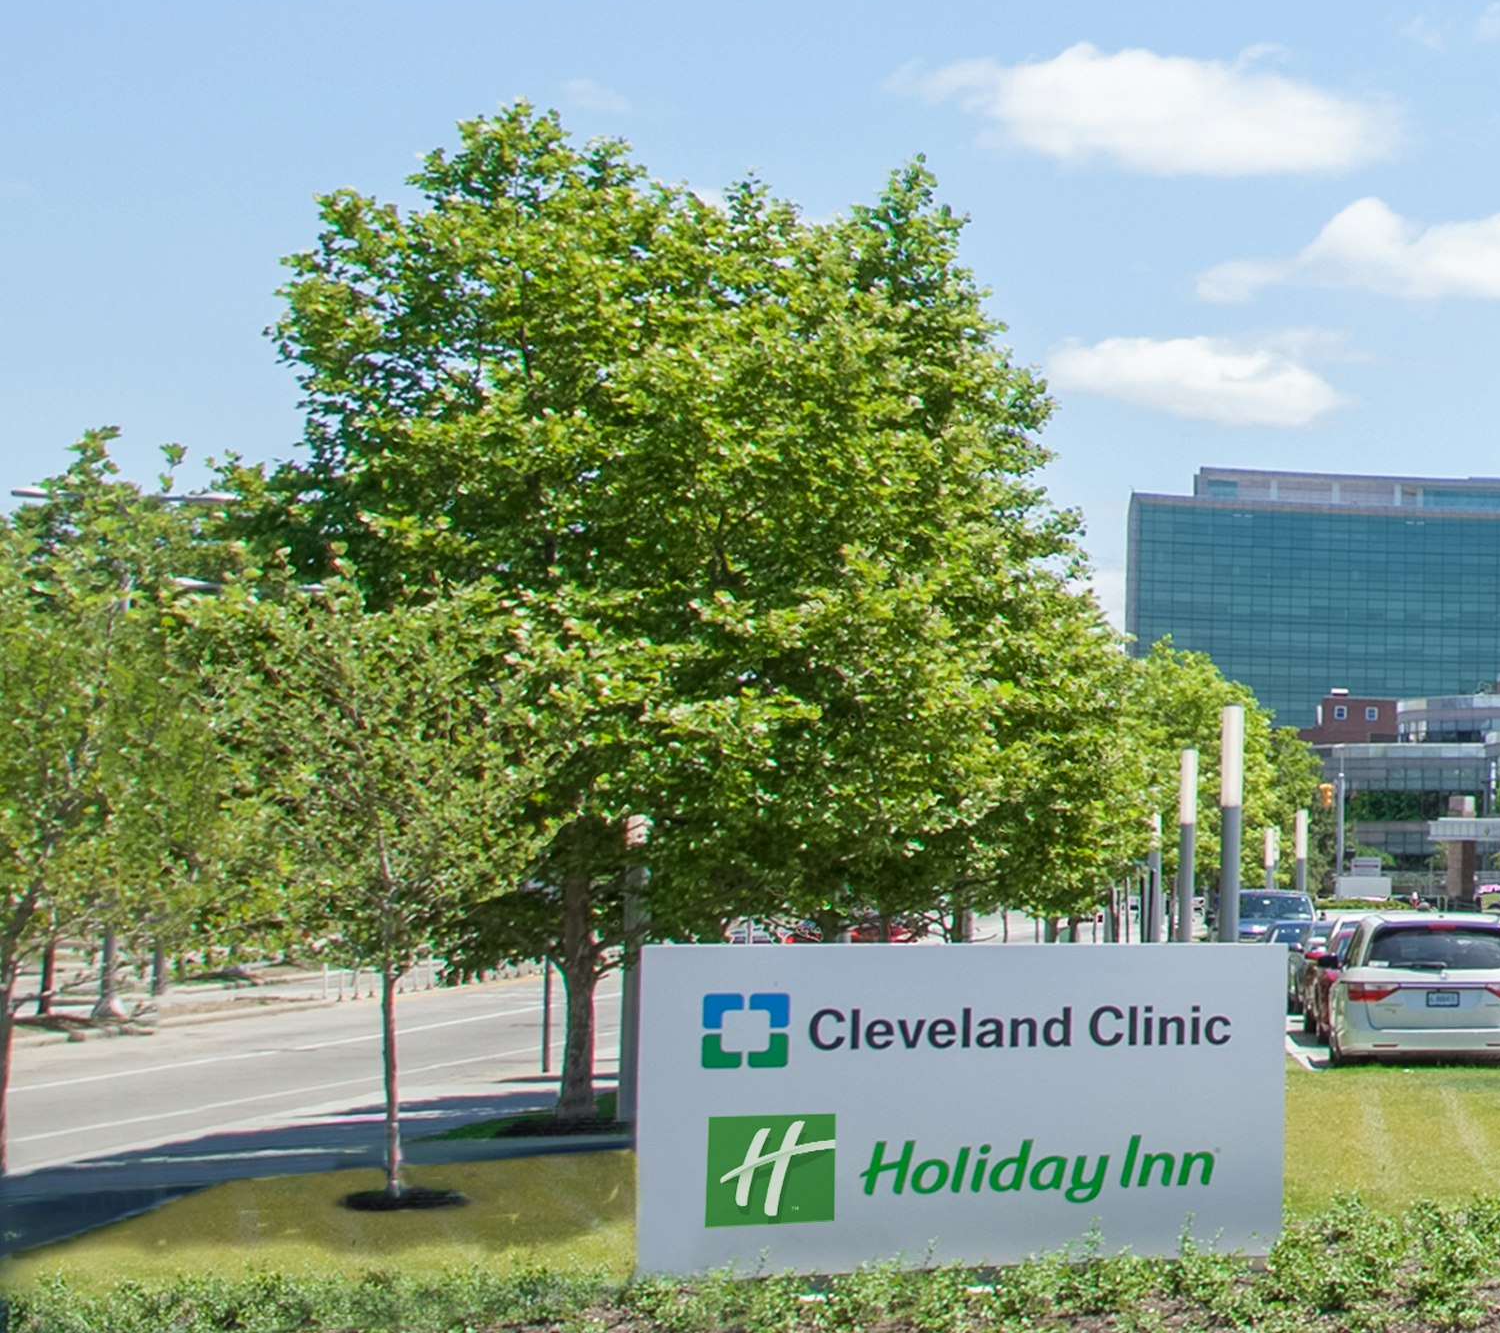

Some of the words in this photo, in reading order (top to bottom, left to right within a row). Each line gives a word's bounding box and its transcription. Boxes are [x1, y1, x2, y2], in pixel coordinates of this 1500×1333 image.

[808, 1005, 1072, 1052] Cleveland
[1088, 1005, 1232, 1047] Clinic
[859, 1138, 1109, 1205] Holiday
[1119, 1135, 1215, 1190] Inn
